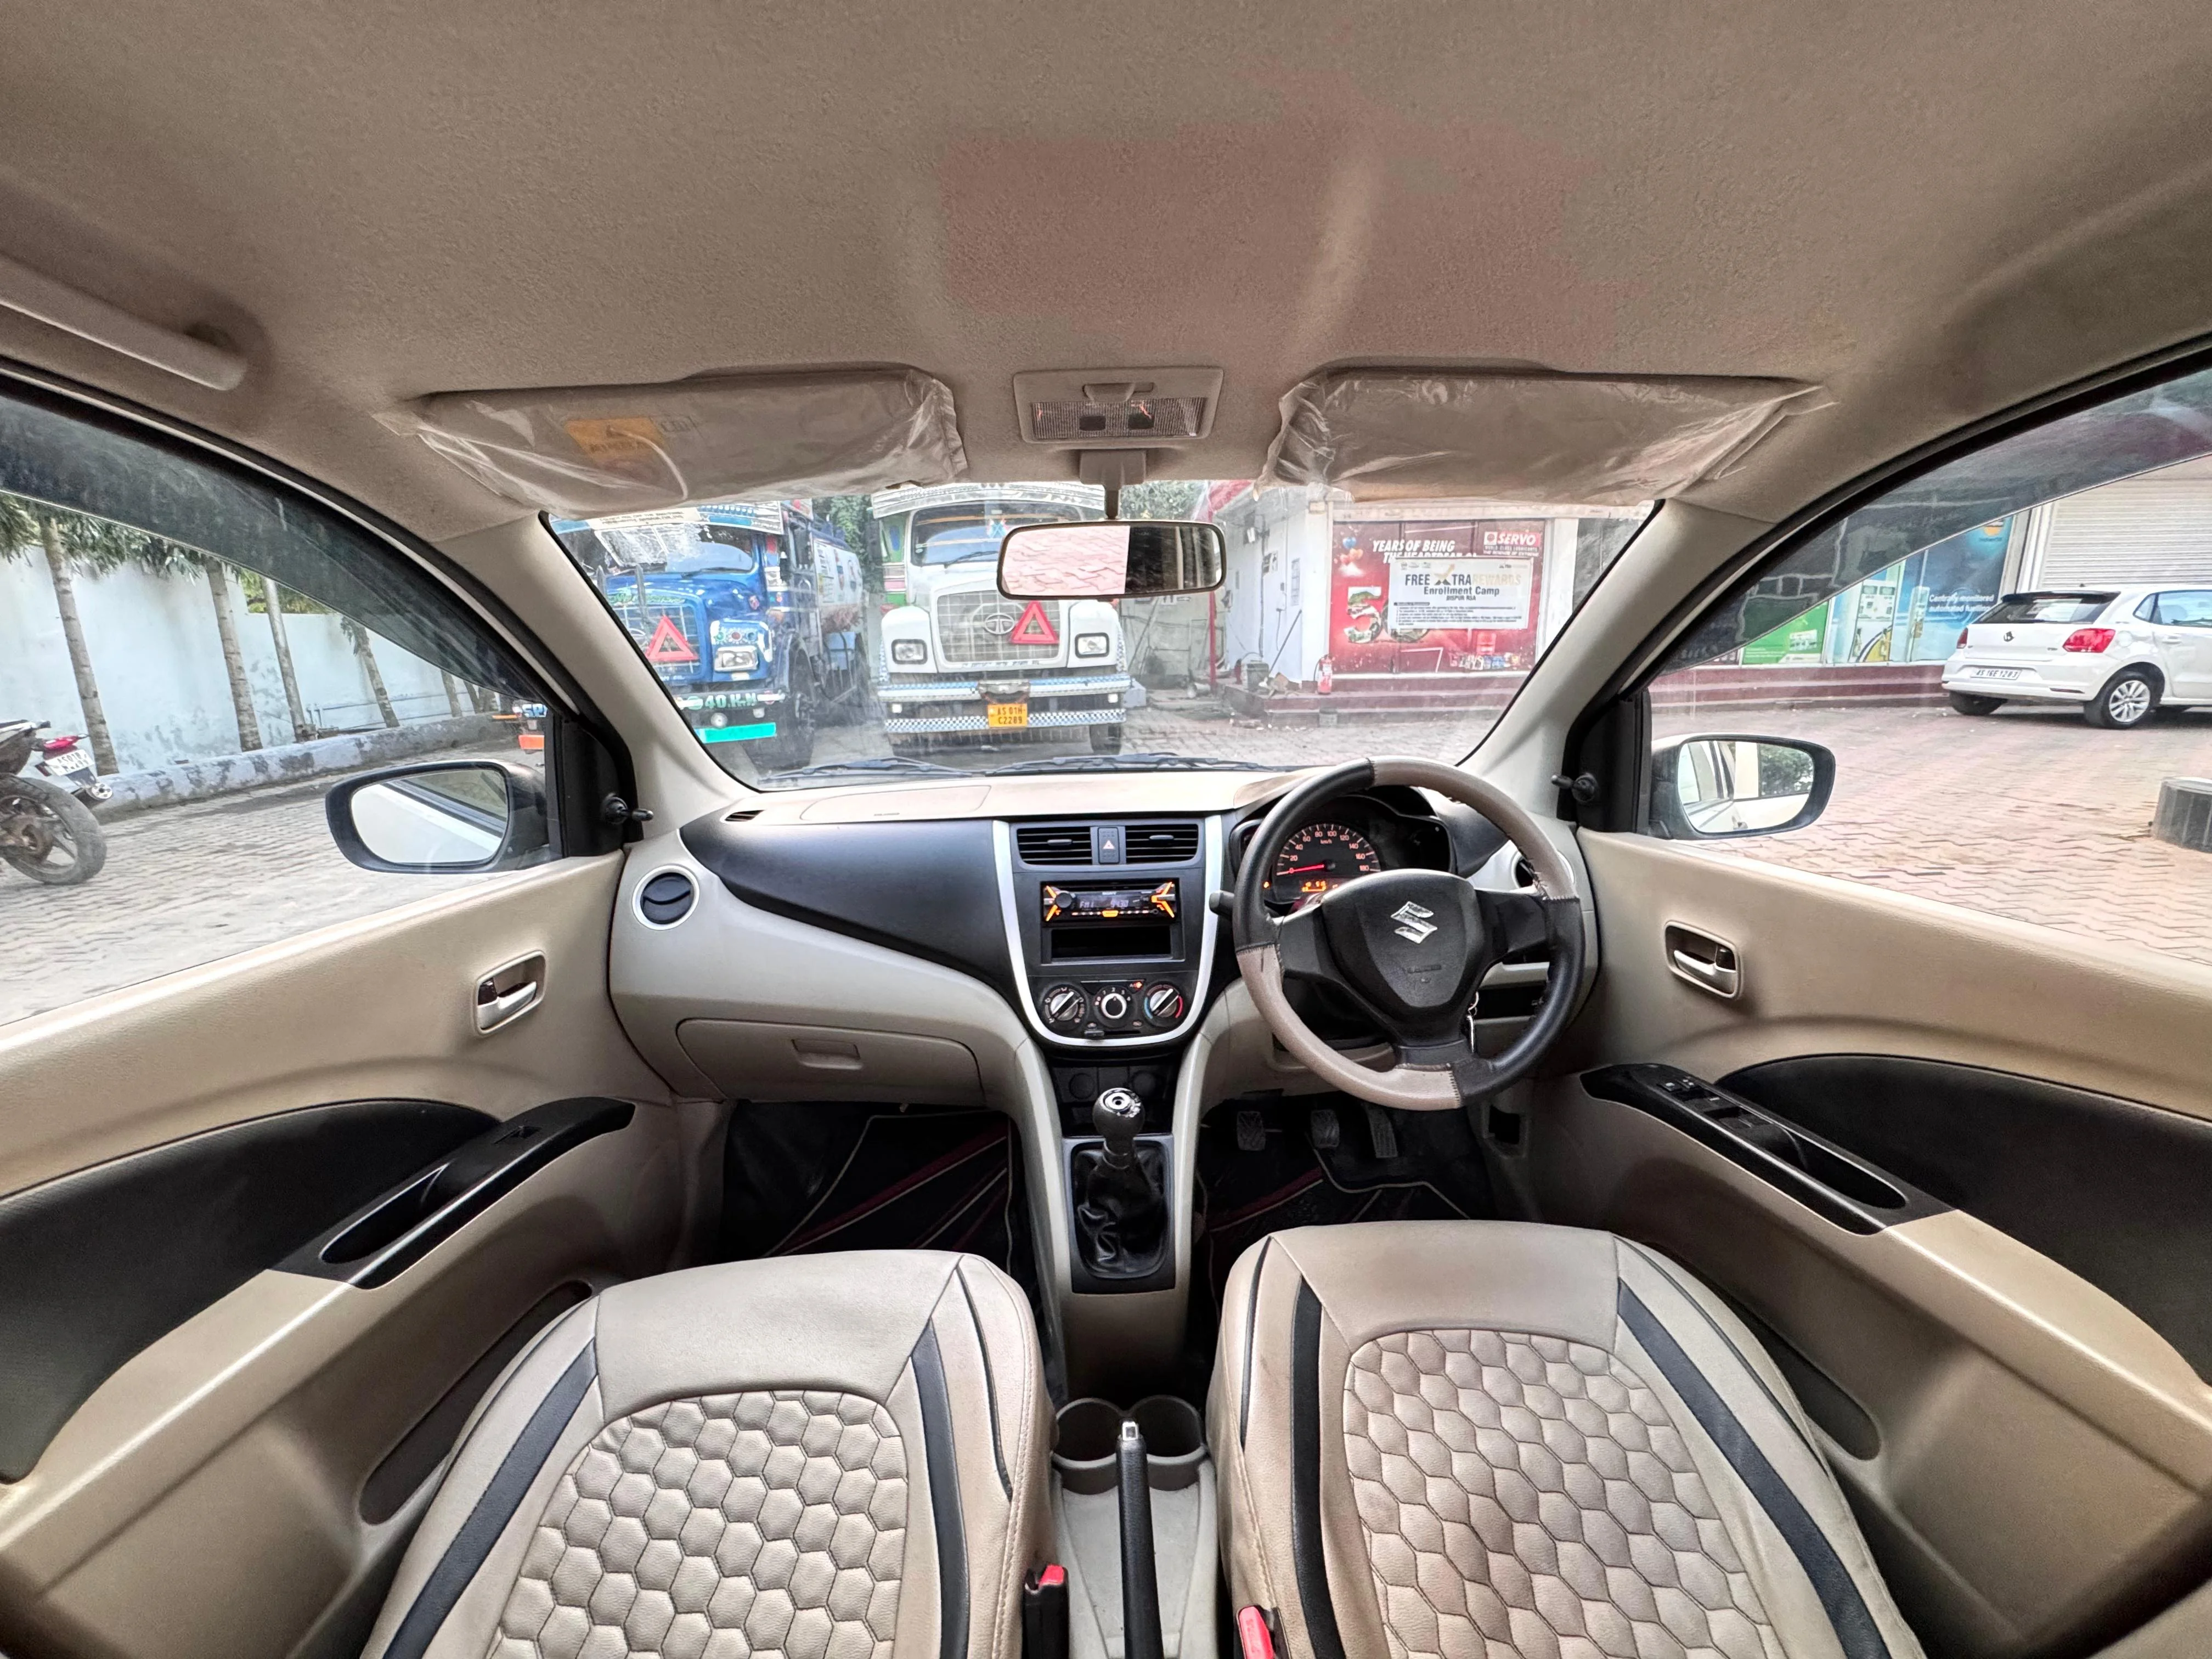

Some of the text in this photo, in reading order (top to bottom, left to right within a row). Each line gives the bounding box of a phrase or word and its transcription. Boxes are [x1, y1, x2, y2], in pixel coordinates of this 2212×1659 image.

[1497, 533, 1537, 545] SERVO
[1373, 540, 1455, 552] YEARS OF BEING
[1405, 574, 1430, 586] FREE
[1424, 586, 1500, 597] Enrollment Camp
[998, 707, 1007, 715] AS
